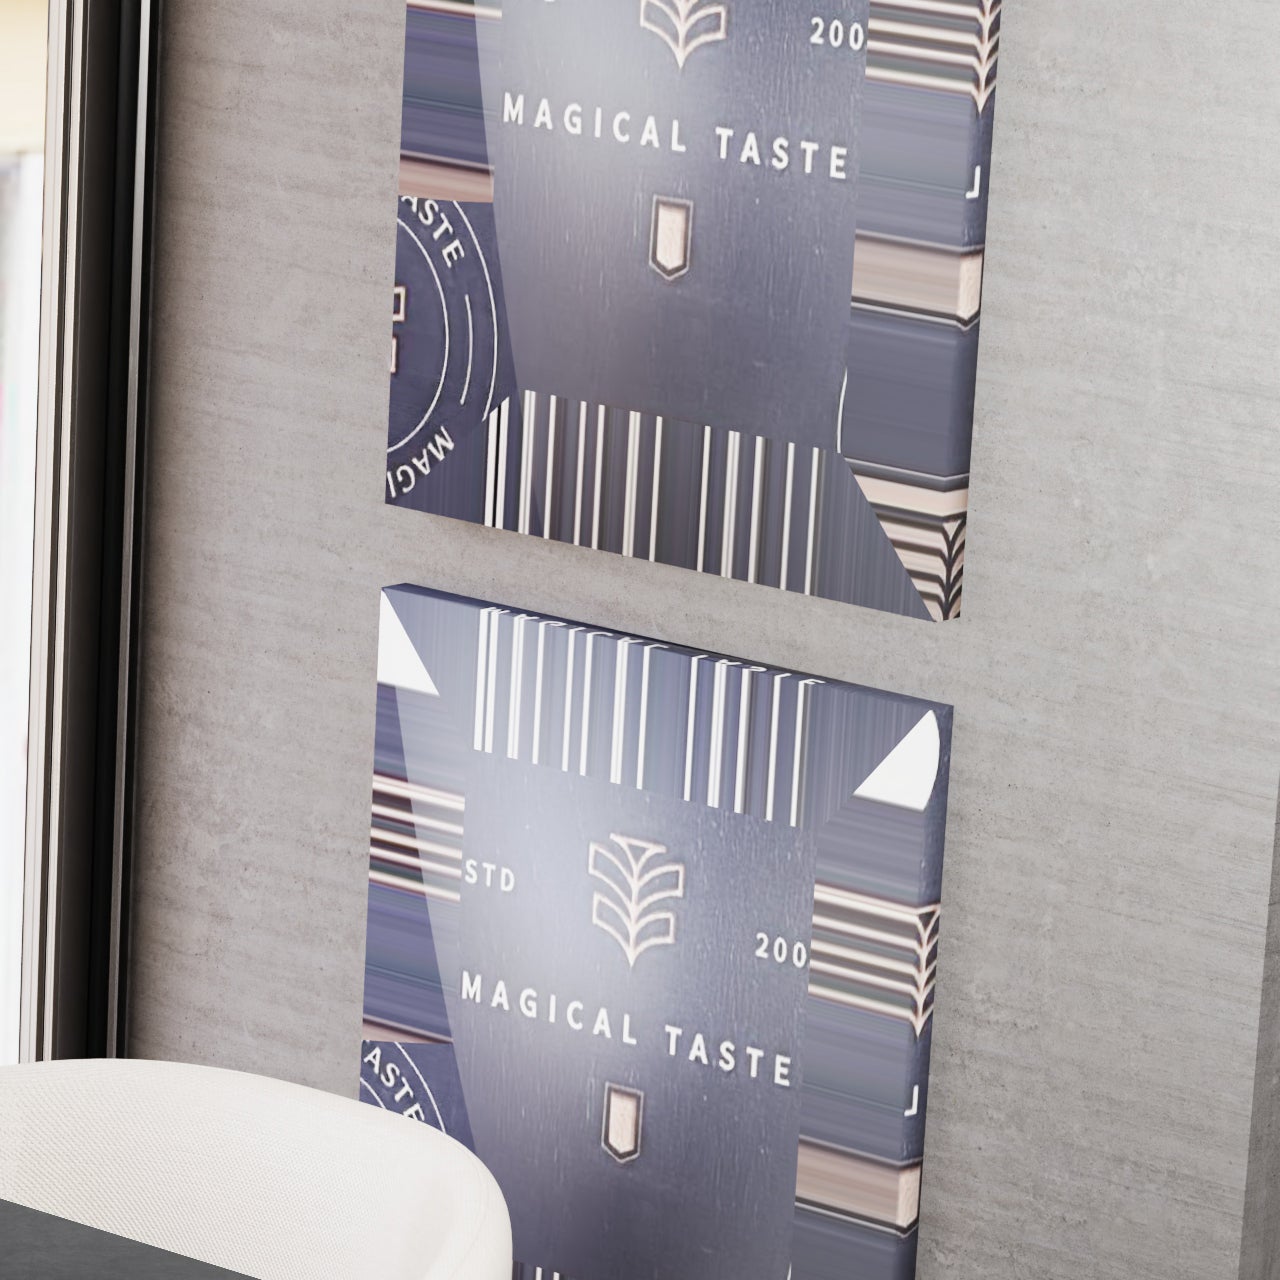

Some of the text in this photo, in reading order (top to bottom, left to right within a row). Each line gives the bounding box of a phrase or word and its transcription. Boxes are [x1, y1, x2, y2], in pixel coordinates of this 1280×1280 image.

[810, 16, 864, 51] 200
[503, 92, 847, 179] MAGICAL TASTE
[464, 859, 515, 892] STD
[755, 932, 807, 969] 200
[461, 971, 791, 1087] MAGICAL TASTE
